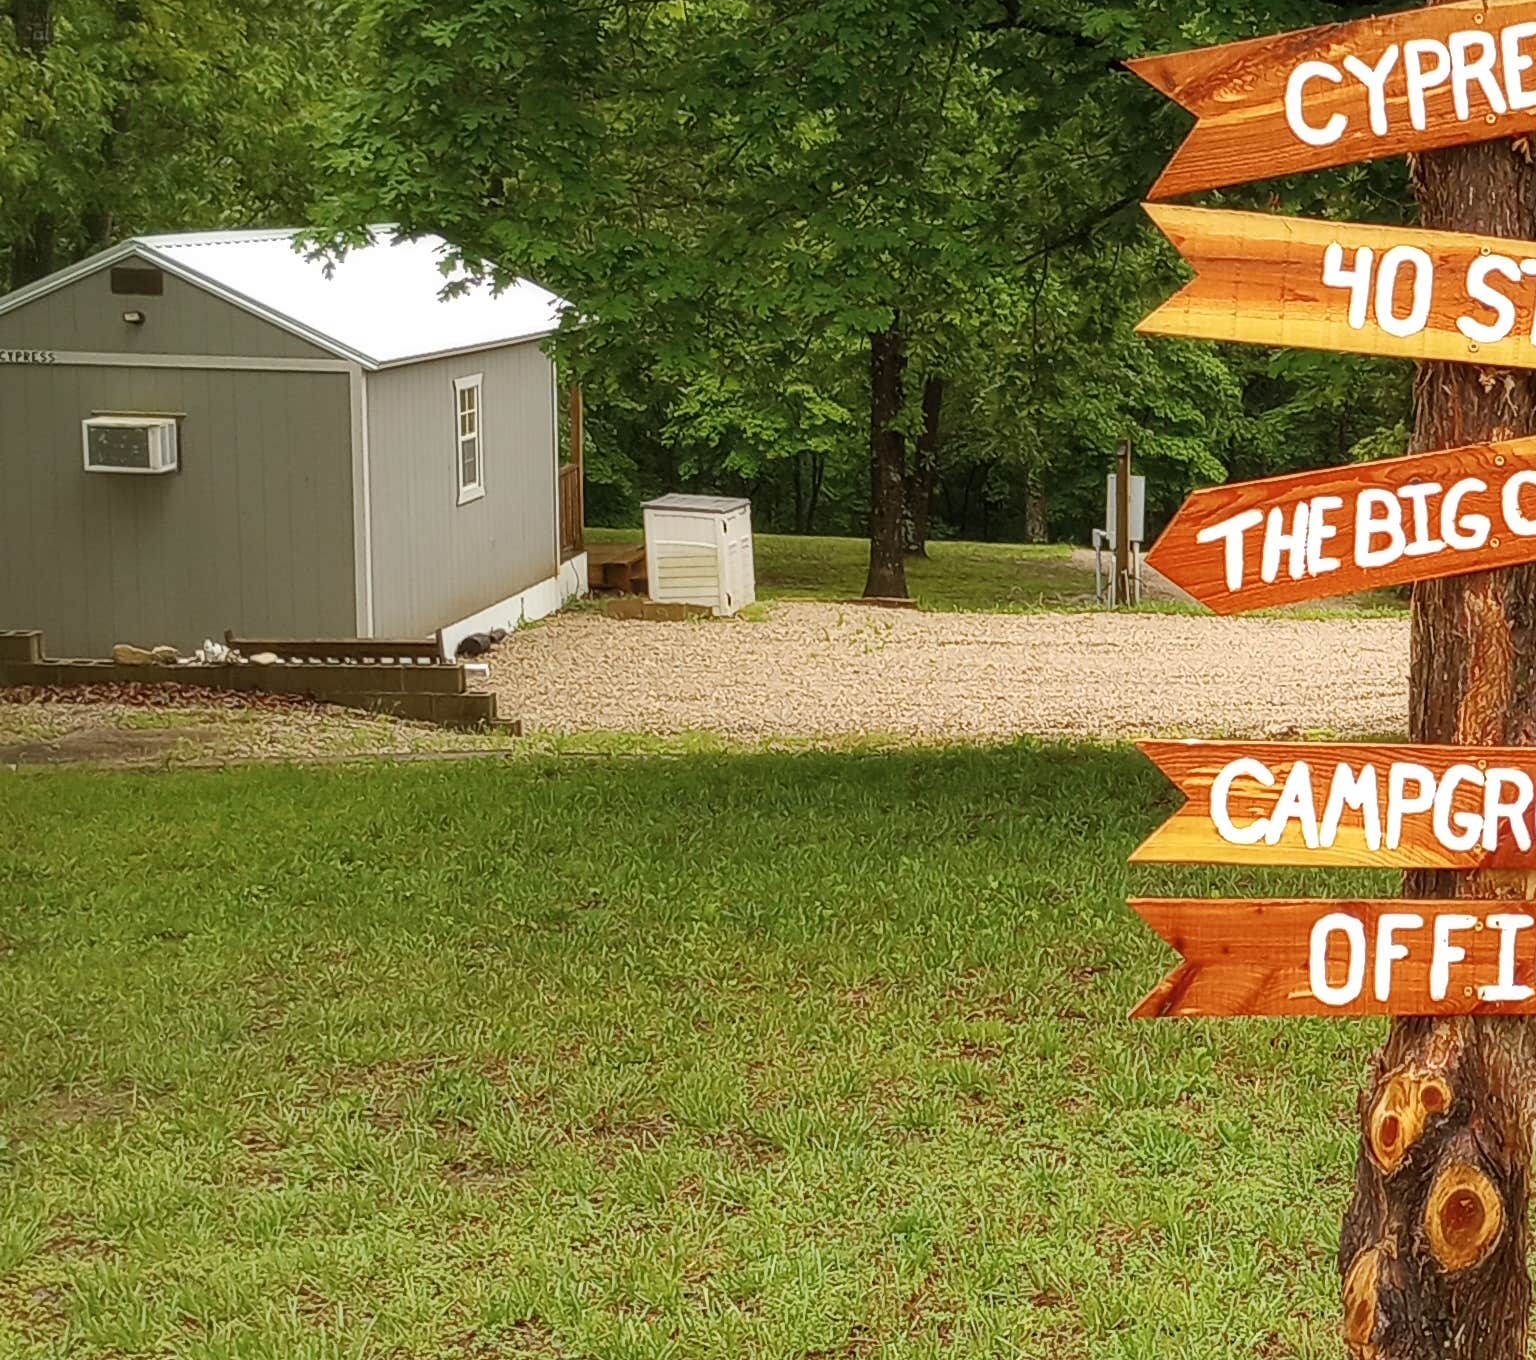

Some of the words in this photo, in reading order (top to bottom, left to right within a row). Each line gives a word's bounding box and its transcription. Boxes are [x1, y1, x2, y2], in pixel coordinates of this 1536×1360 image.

[1323, 242, 1434, 338] 40
[0, 350, 56, 362] CYPRESS
[1197, 496, 1343, 591] THE
[1354, 478, 1491, 568] BIG
